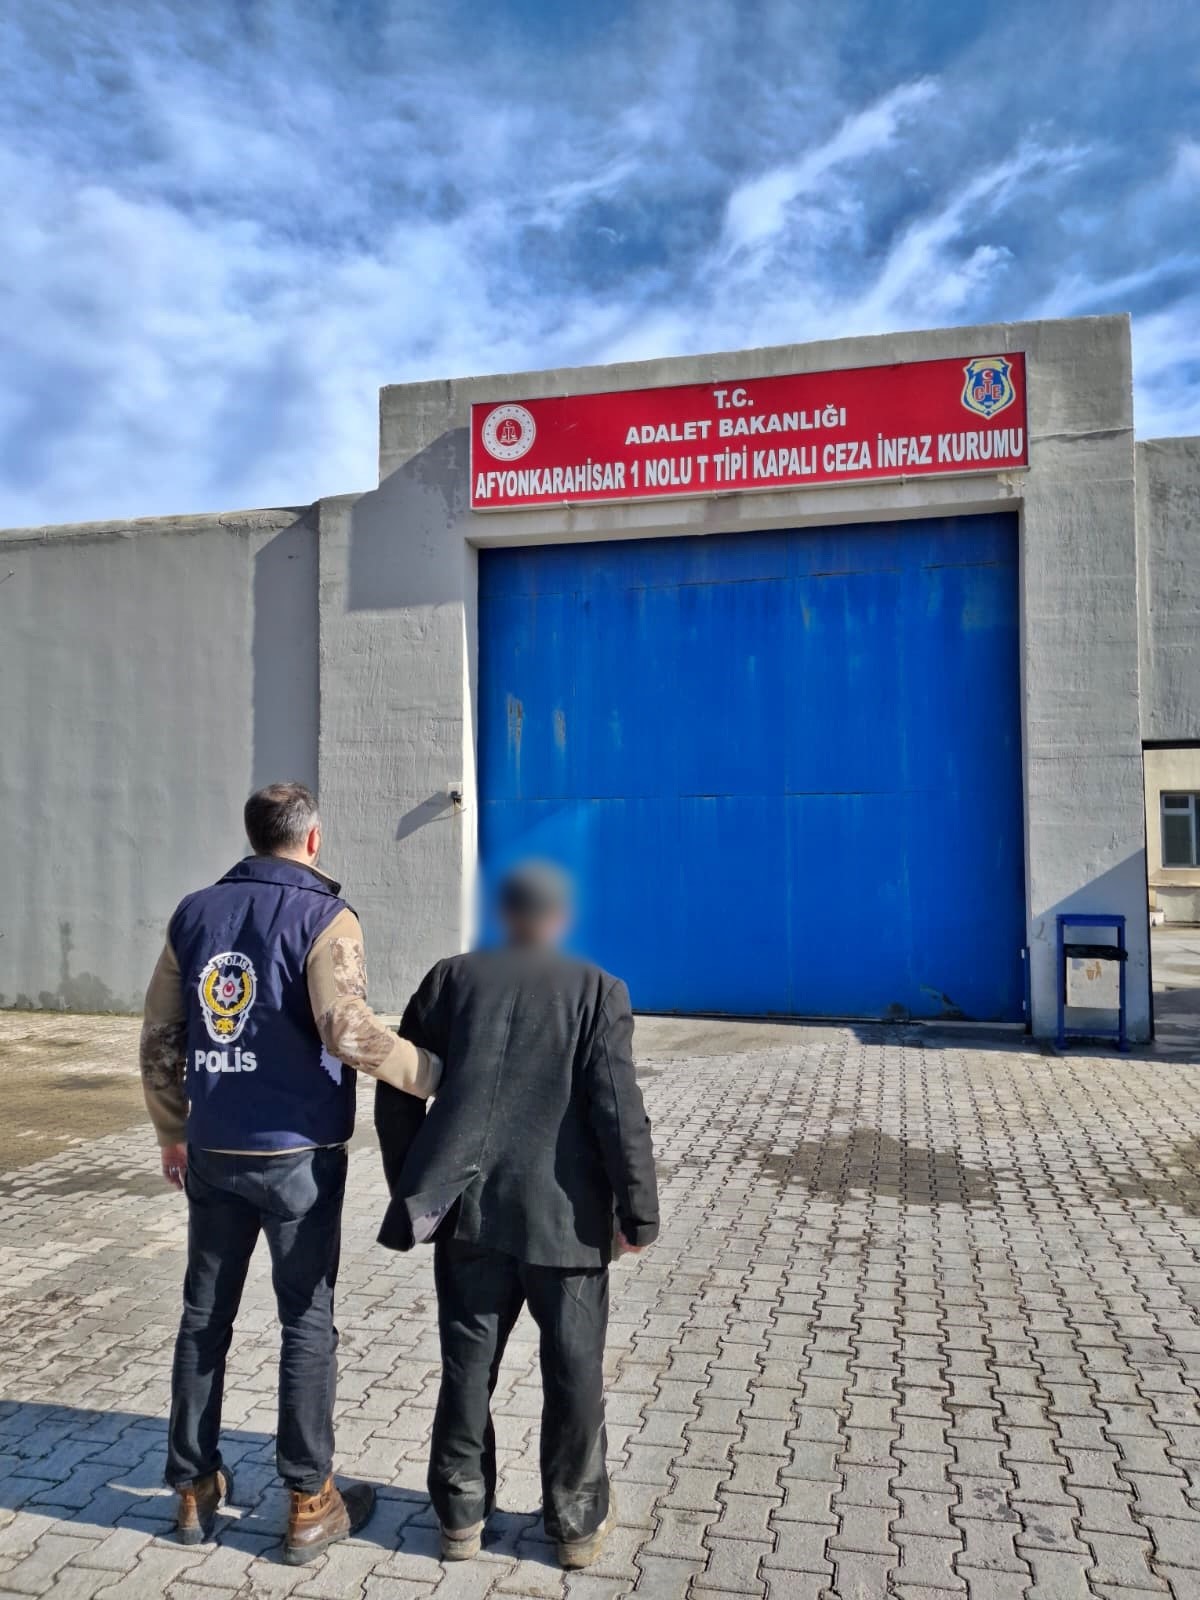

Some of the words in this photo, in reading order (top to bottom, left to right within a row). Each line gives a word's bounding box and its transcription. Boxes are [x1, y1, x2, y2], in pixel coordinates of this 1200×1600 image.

[713, 388, 754, 409] T.C.
[625, 419, 712, 446] ADALET
[719, 404, 847, 437] BAKANLIĞI
[475, 457, 626, 499] AFYONKARAHİSAR
[630, 460, 639, 488] 1
[645, 456, 692, 487] NOLU
[697, 455, 708, 483] T
[714, 444, 747, 482] TİPİ
[753, 445, 817, 479] KAPALI
[823, 440, 872, 473] CEZA
[877, 432, 932, 468] İNFAZ
[938, 427, 1024, 463] KURUMU
[194, 1046, 258, 1073] POLİS
